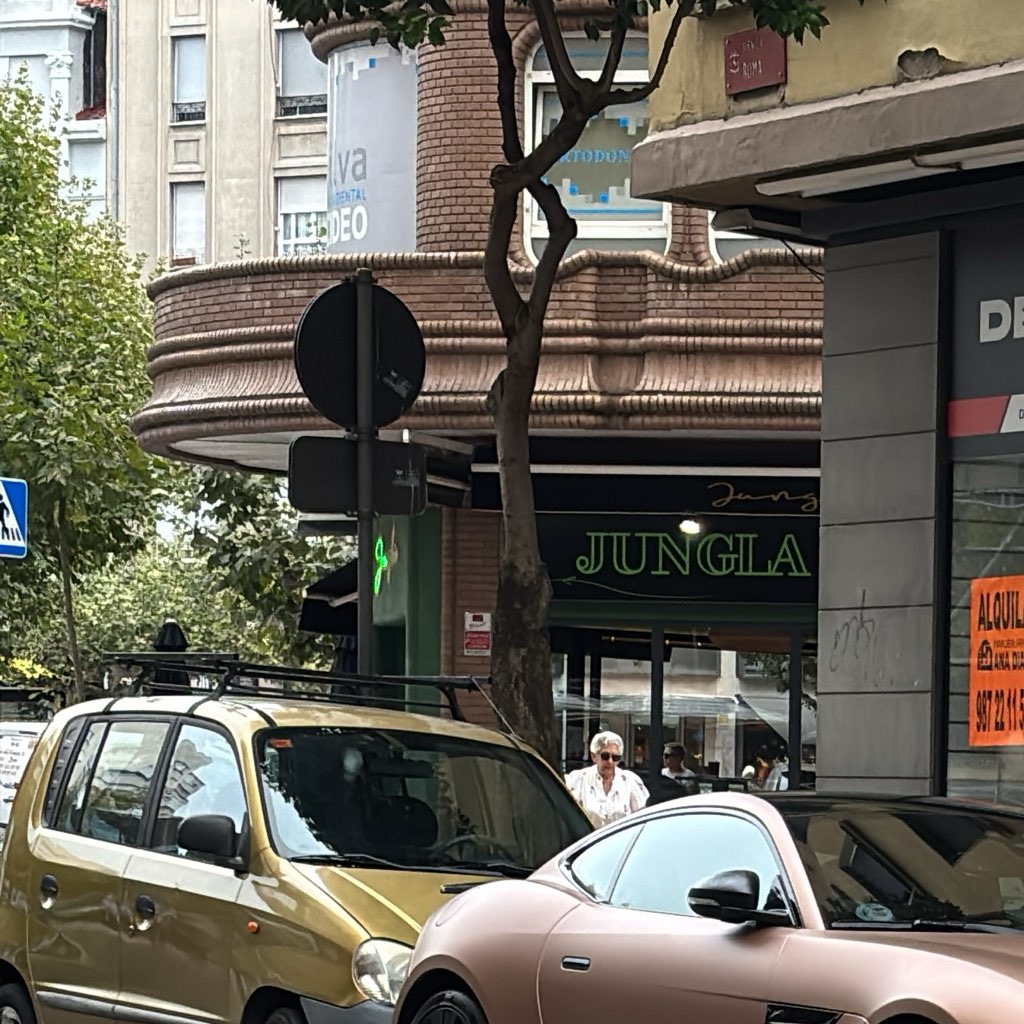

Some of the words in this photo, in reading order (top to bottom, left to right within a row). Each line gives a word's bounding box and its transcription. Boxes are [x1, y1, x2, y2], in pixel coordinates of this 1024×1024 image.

[576, 532, 812, 577] JUNGLA
[994, 652, 1010, 671] ANA
[976, 690, 992, 732] 987
[994, 689, 1005, 731] 22
[1007, 689, 1017, 731] 11
